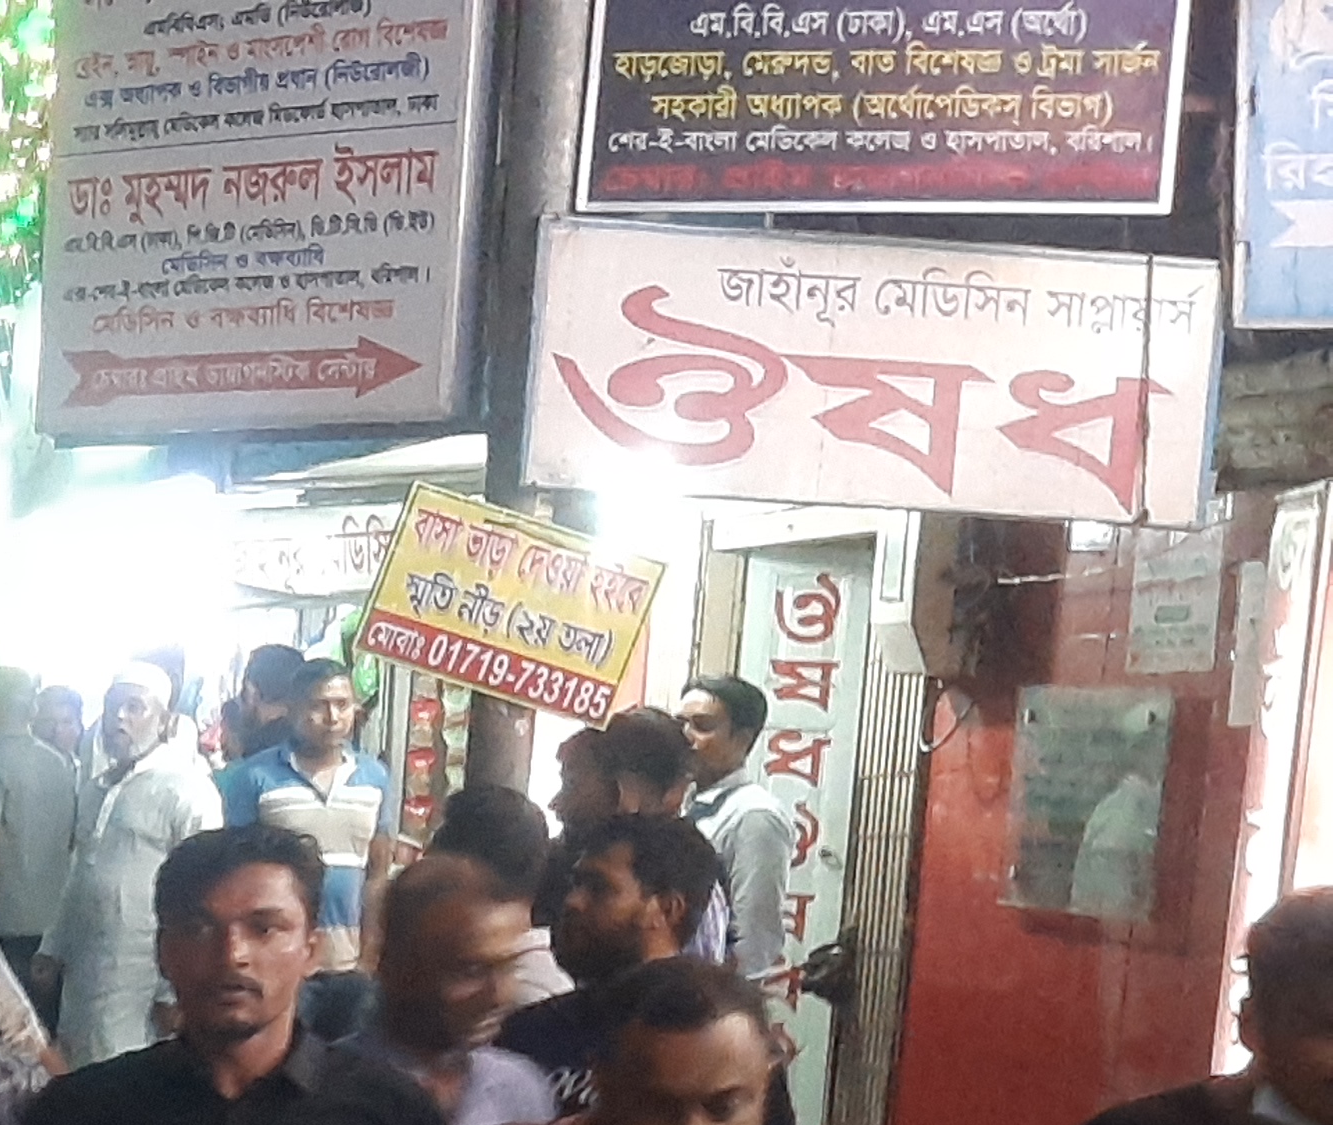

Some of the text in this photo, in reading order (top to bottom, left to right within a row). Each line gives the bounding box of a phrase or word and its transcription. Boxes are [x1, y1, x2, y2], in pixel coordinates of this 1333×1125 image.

[334, 28, 370, 52] রোগ
[377, 17, 448, 47] বিশেষজ্ঞ
[689, 1, 1088, 43] এম.বি.বি.এস (ঢাকা), এম.এস (অর্থো)
[188, 80, 201, 97] ও
[208, 67, 269, 98] বিভাগীয়
[275, 68, 318, 90] প্রধান
[613, 51, 733, 84] হাড়জোড়া,
[850, 50, 897, 75] বাত
[905, 40, 1004, 76] বিশেষজ্ঞ
[1012, 50, 1031, 76] ও
[1036, 44, 1085, 80] ট্রমা
[1092, 40, 1161, 77] সার্জন
[407, 94, 439, 112] ঢাকা
[651, 84, 1114, 127] সহকারী অধ্যাপক (অর্থোপেডিকস্ বিভাগ)
[608, 128, 738, 153] শের-ই-বাংলা
[745, 124, 838, 152] মেডিকেল
[845, 130, 911, 152] কলেজ
[920, 130, 938, 151] ও
[945, 130, 1058, 156] হাসপাতাল,
[68, 175, 112, 219] ডাঃ
[222, 157, 324, 206] নজরুল
[332, 143, 439, 205] ইসলাম
[162, 250, 228, 275] মেডিসিন
[235, 253, 248, 268] ও
[279, 275, 290, 289] ও
[93, 305, 175, 335] মেডিসিন
[186, 310, 200, 328] ও
[305, 296, 395, 325] বিশেষজ্ঞ
[874, 267, 1031, 326] মেডিসিন
[317, 351, 378, 382] সেন্টার
[552, 285, 1175, 515] ঔষধ
[416, 508, 464, 550] বাসা
[467, 523, 519, 579] ভাড়া
[519, 544, 591, 594] দেওয়া
[458, 583, 506, 634] নীড়
[506, 601, 556, 649] (২য়
[558, 623, 615, 669] তলা)
[368, 621, 612, 719] মোবাঃ 01719-733185
